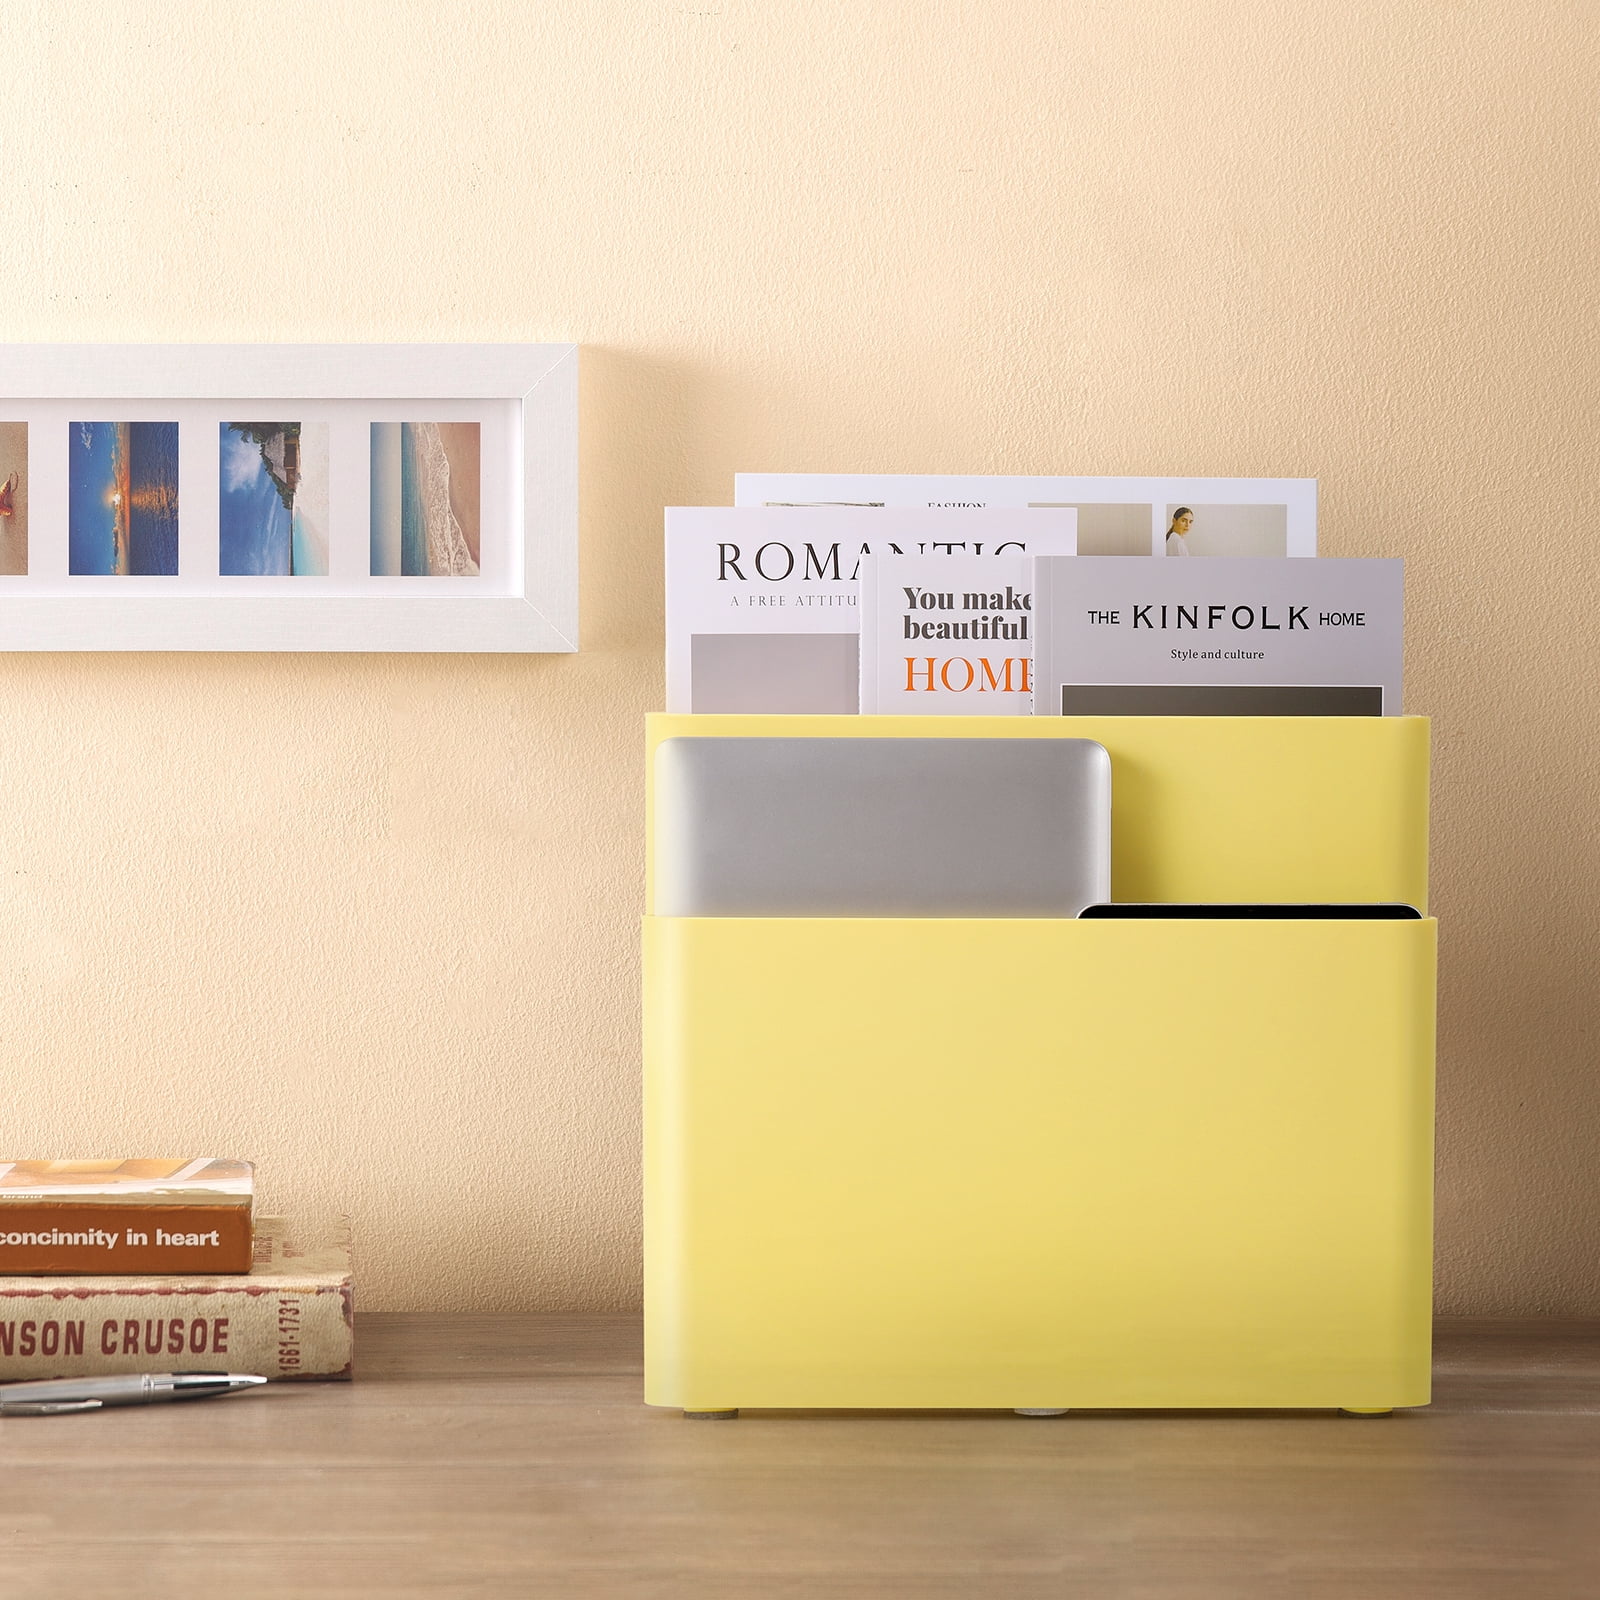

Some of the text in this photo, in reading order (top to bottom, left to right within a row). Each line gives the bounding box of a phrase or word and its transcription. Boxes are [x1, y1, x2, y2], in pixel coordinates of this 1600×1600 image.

[730, 595, 857, 606] A FREE ATTITU
[903, 587, 954, 610] You
[903, 615, 1028, 640] beautiful
[1088, 605, 1366, 630] THE KINFOLK HOME
[1171, 648, 1265, 661] Style and culture
[126, 1228, 148, 1246] in
[156, 1229, 220, 1246] heart
[0, 1318, 229, 1356] NSON CRUSOE
